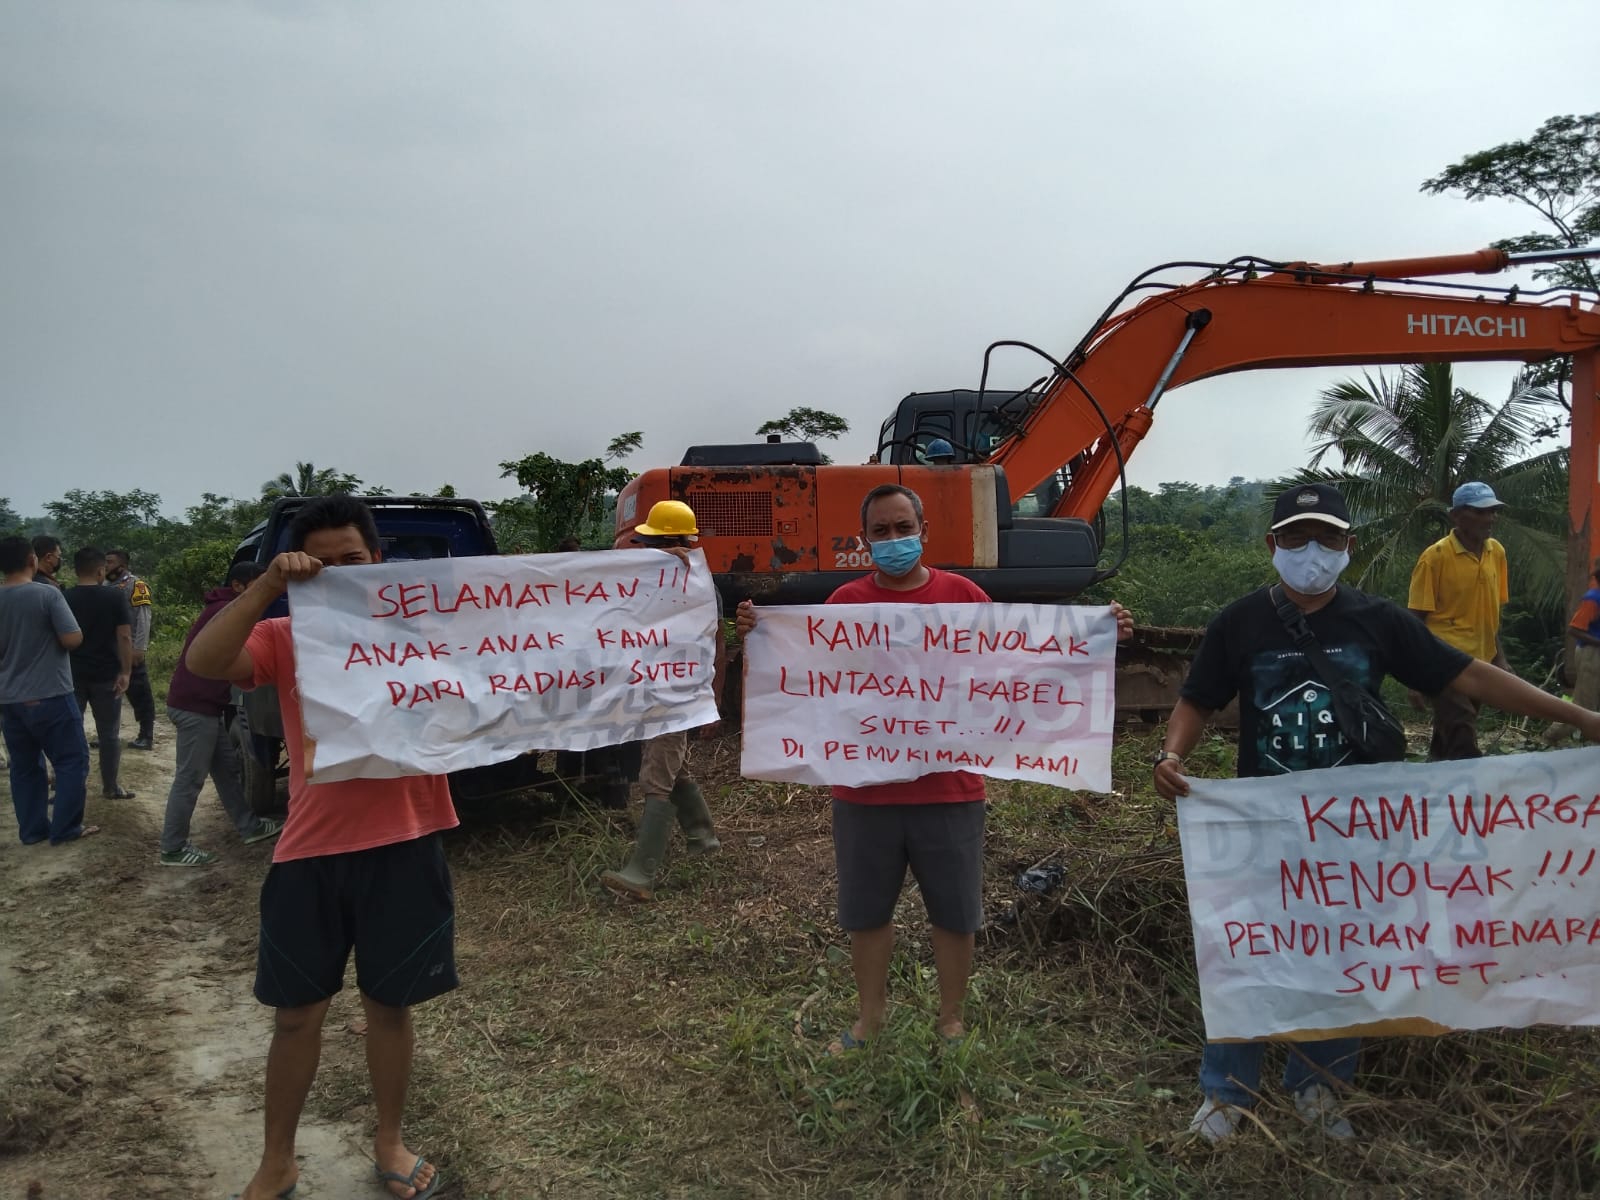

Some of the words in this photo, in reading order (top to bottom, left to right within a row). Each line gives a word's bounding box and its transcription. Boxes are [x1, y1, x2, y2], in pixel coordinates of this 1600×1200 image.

[1407, 313, 1526, 338] HITACHI
[834, 551, 873, 568] 200
[344, 631, 565, 671] ANAK-ANAK
[596, 628, 669, 649] KAMI
[807, 615, 890, 652] KAMI
[923, 623, 1090, 657] MENOLAK
[386, 679, 465, 710] DARI
[489, 669, 606, 696] RADIASI
[628, 659, 700, 686] SUTET
[779, 665, 946, 703] LINTASAN
[967, 677, 1085, 707] KABEL
[782, 737, 805, 760] DI
[824, 741, 995, 770] PEMUKIMAN
[1015, 753, 1079, 777] KAMI
[1301, 793, 1429, 843] KAMI
[1448, 793, 1600, 838] WARGA
[1280, 857, 1515, 911] MENOLAK
[1224, 920, 1431, 959] PENDIRIAN
[1455, 918, 1600, 948] MENARA
